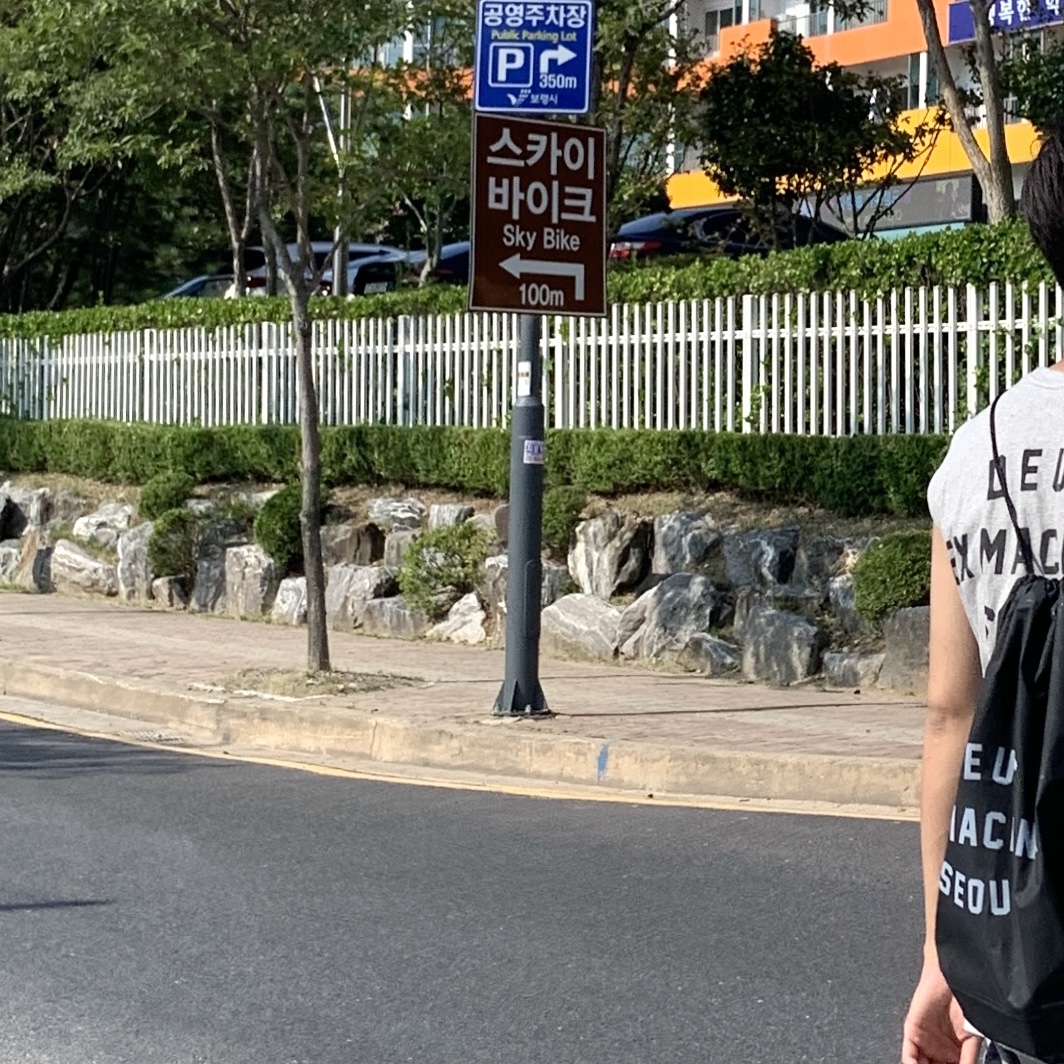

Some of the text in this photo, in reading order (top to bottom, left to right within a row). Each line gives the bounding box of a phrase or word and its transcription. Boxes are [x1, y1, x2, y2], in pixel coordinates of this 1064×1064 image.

[484, 3, 587, 29] 공영주차장
[491, 29, 578, 44] Public Parking Lot
[497, 48, 525, 82] P
[539, 73, 578, 90] 350m
[486, 127, 596, 181] 스카이
[488, 175, 597, 225] 바이크
[503, 223, 581, 252] Sky Bike
[519, 282, 565, 308] 100m
